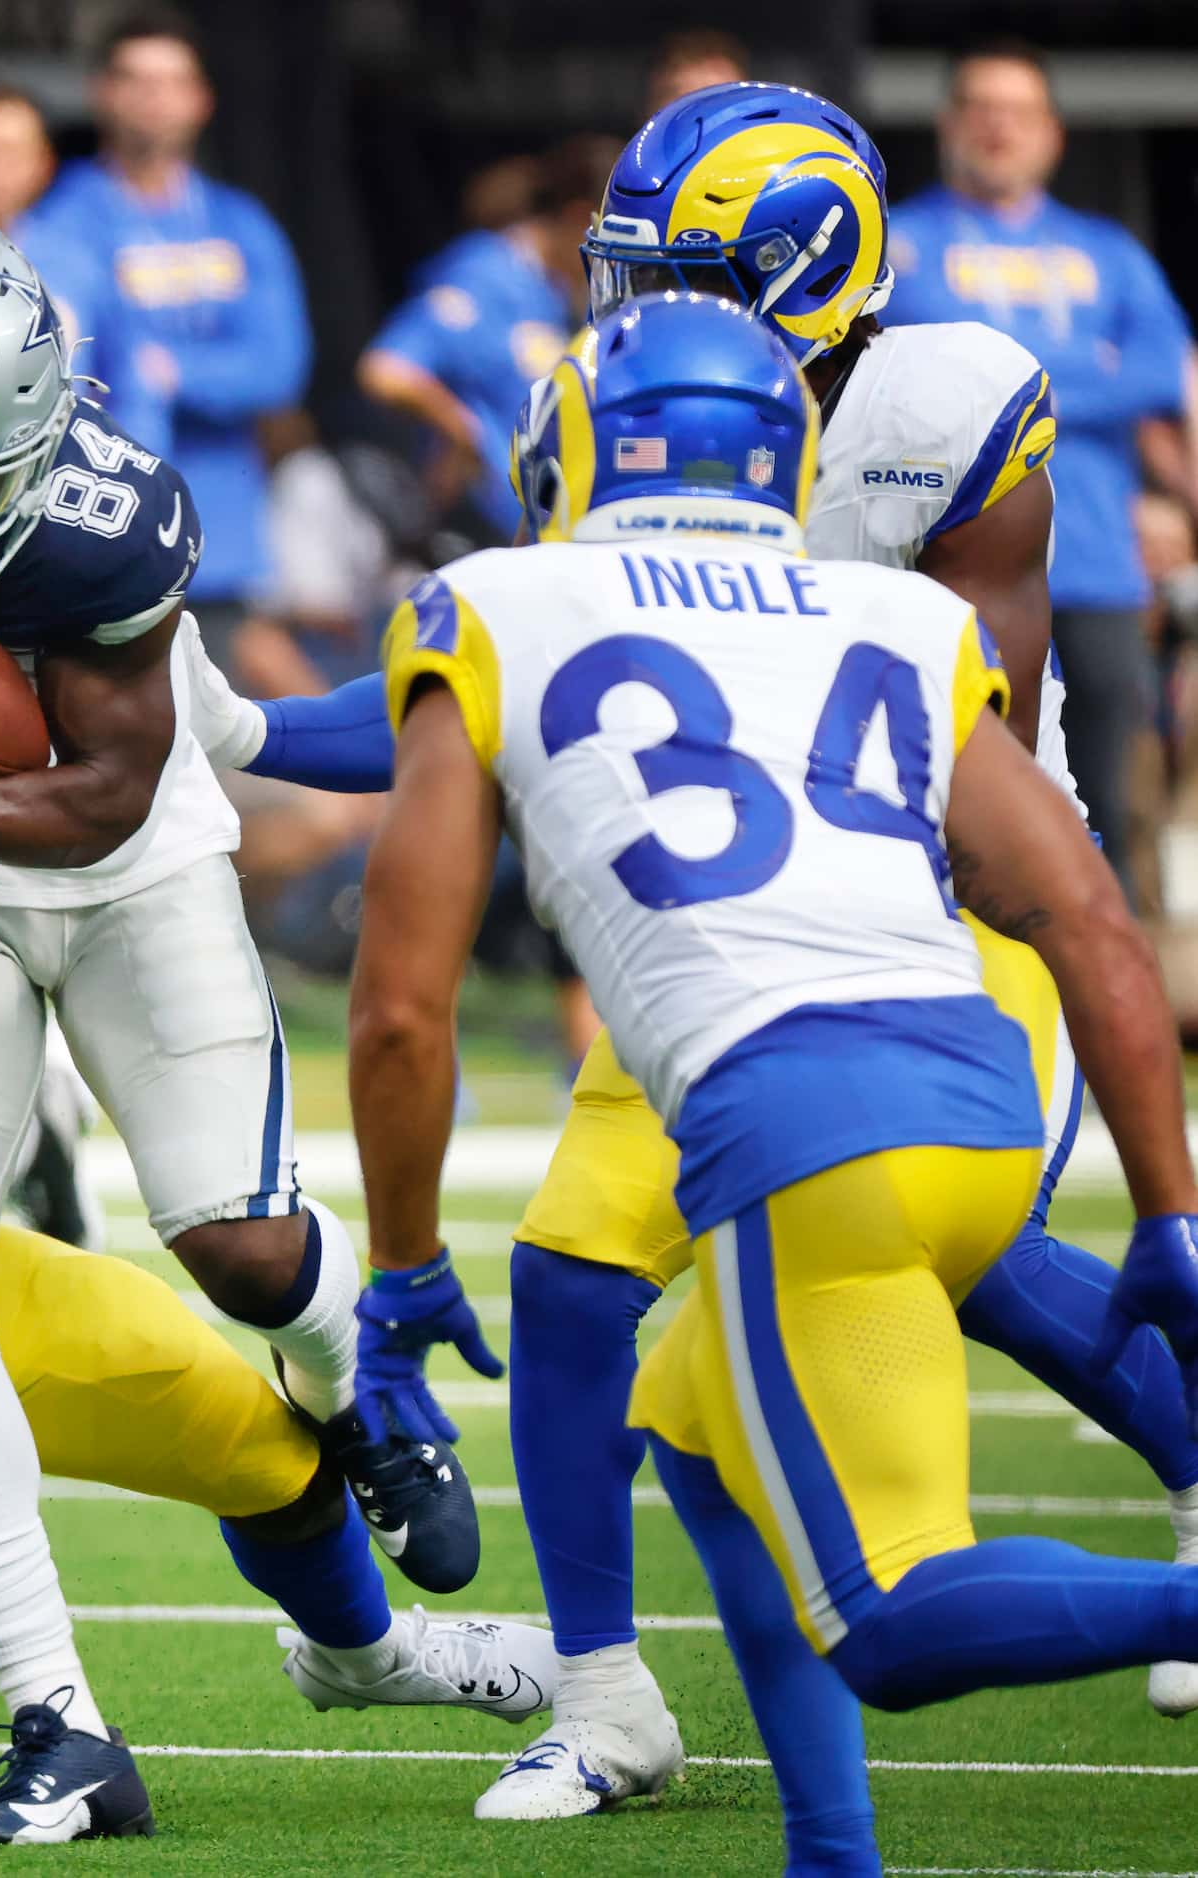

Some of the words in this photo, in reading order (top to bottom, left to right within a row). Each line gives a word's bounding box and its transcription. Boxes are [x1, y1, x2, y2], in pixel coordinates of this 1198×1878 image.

[43, 417, 162, 539] 84
[862, 469, 944, 488] RAMS
[616, 515, 667, 530] LOS
[673, 516, 784, 537] ANGELES
[619, 552, 829, 616] INGLE
[540, 633, 963, 921] 34
